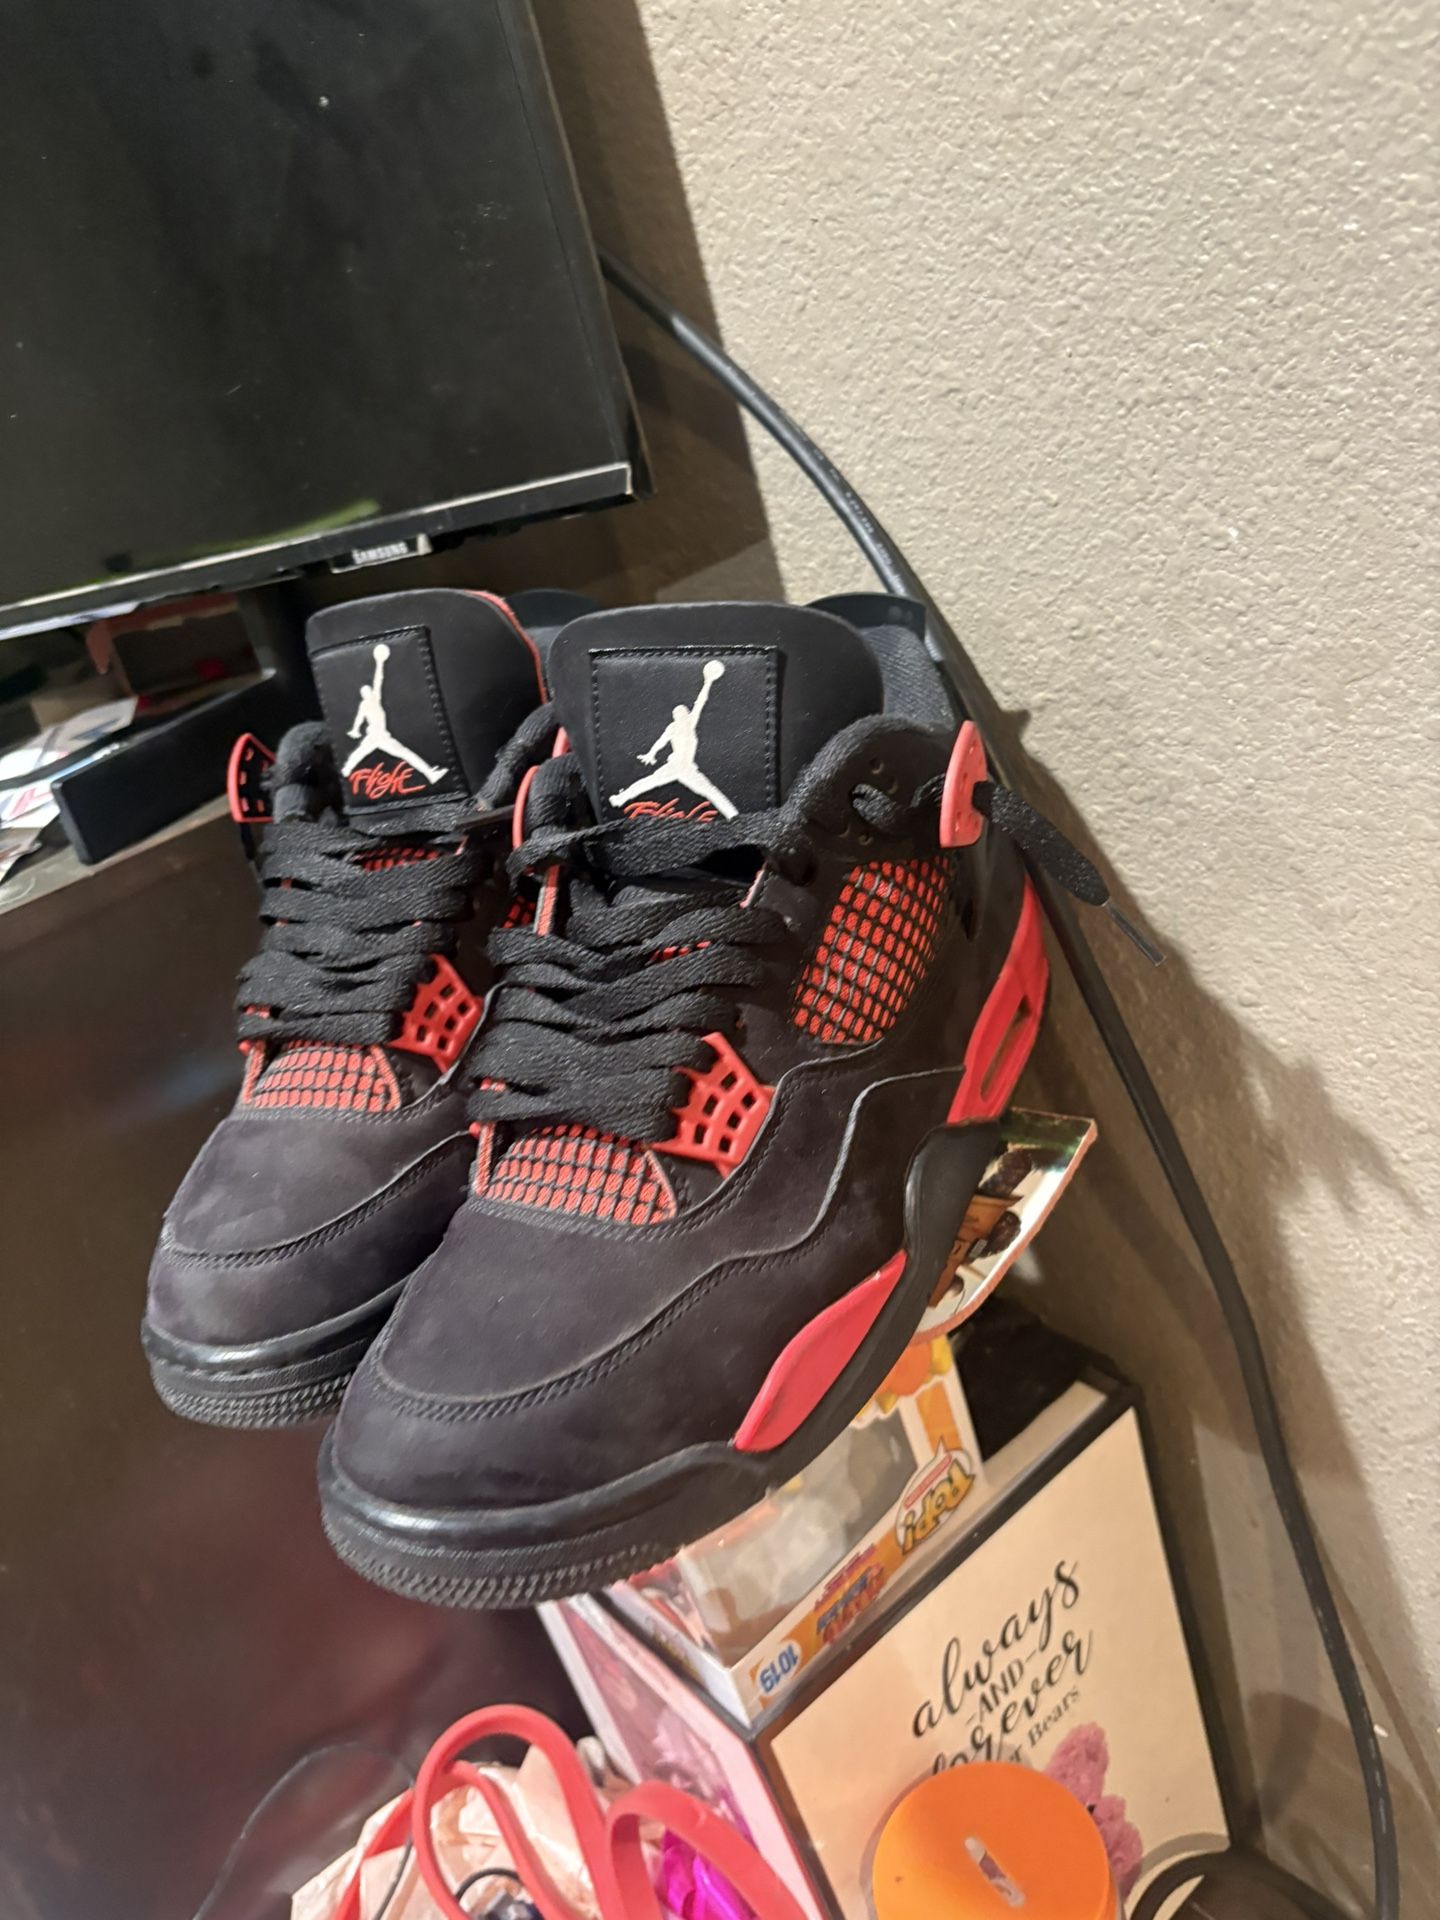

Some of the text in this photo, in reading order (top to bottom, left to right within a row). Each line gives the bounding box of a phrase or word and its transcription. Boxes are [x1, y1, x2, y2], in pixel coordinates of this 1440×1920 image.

[760, 1643, 798, 1692] 1019
[911, 1559, 1080, 1738] always
[1026, 1684, 1081, 1749] Bears
